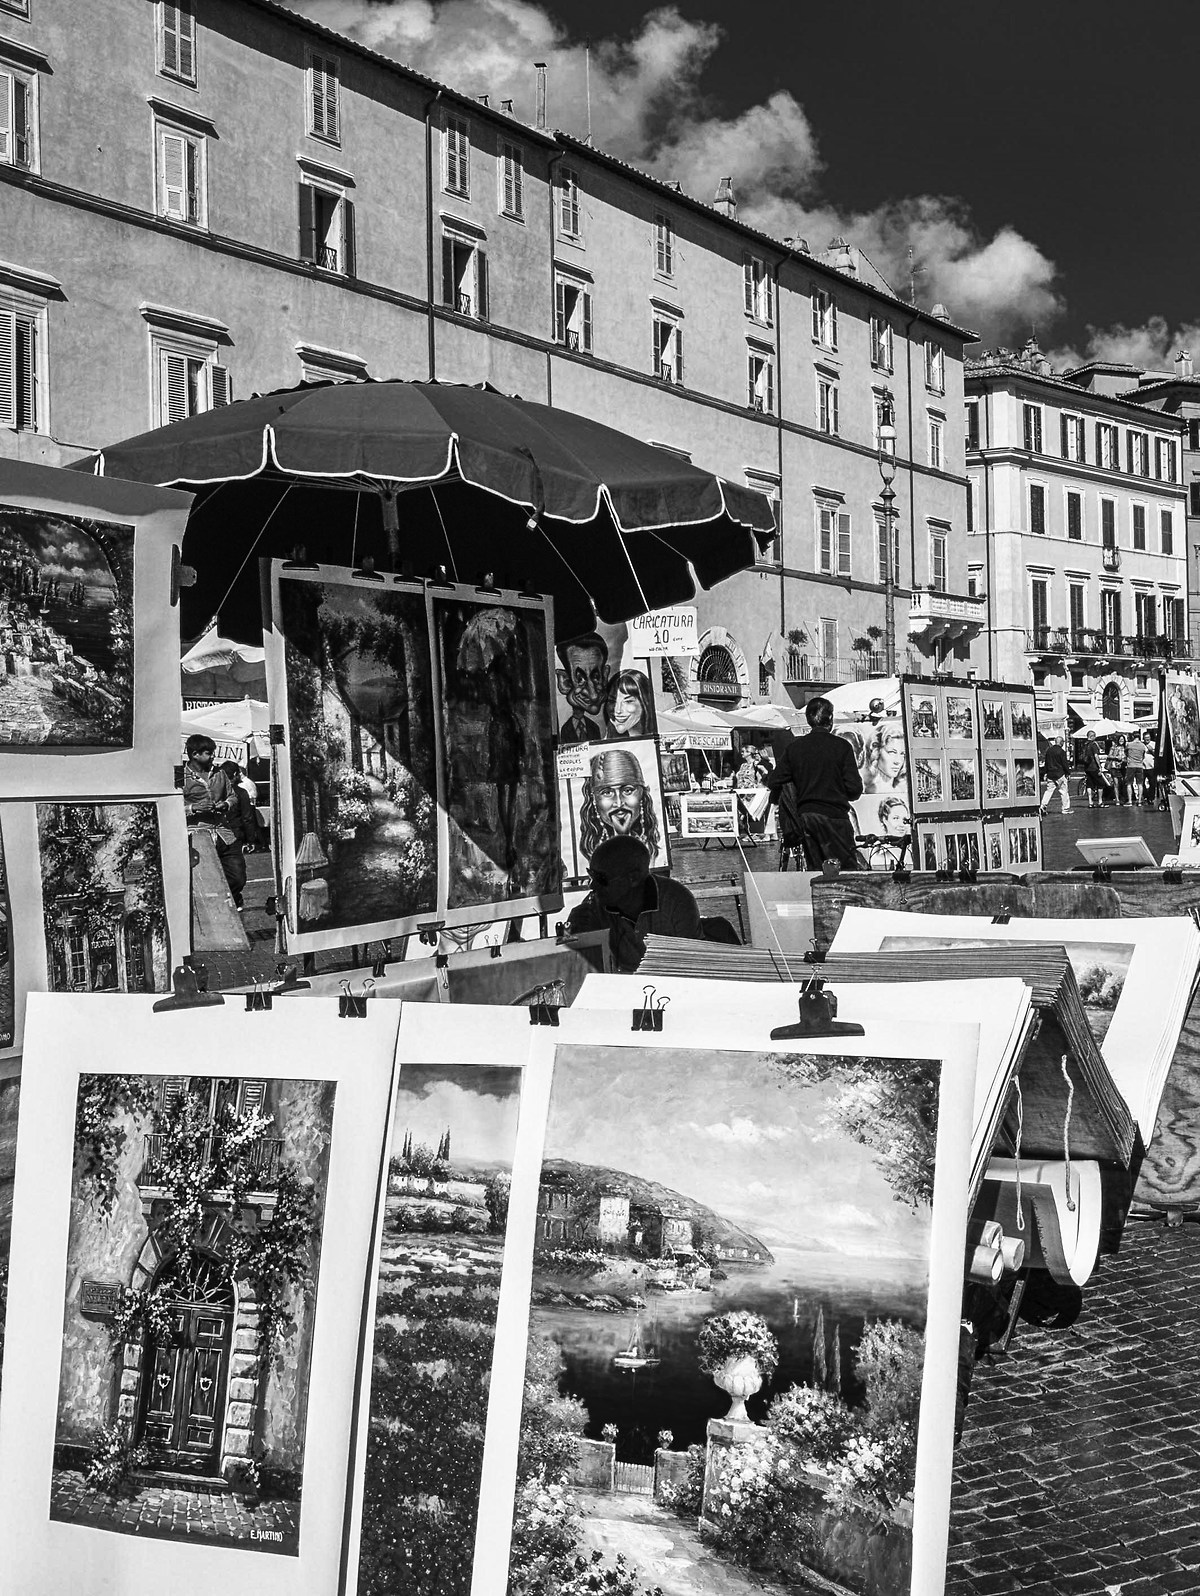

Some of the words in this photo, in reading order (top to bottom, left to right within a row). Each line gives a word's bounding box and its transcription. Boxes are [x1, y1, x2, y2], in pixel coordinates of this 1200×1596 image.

[633, 615, 694, 629] CARICATURA
[654, 629, 669, 644] 10
[703, 684, 738, 695] RISTORANTE
[212, 745, 243, 761] LINI
